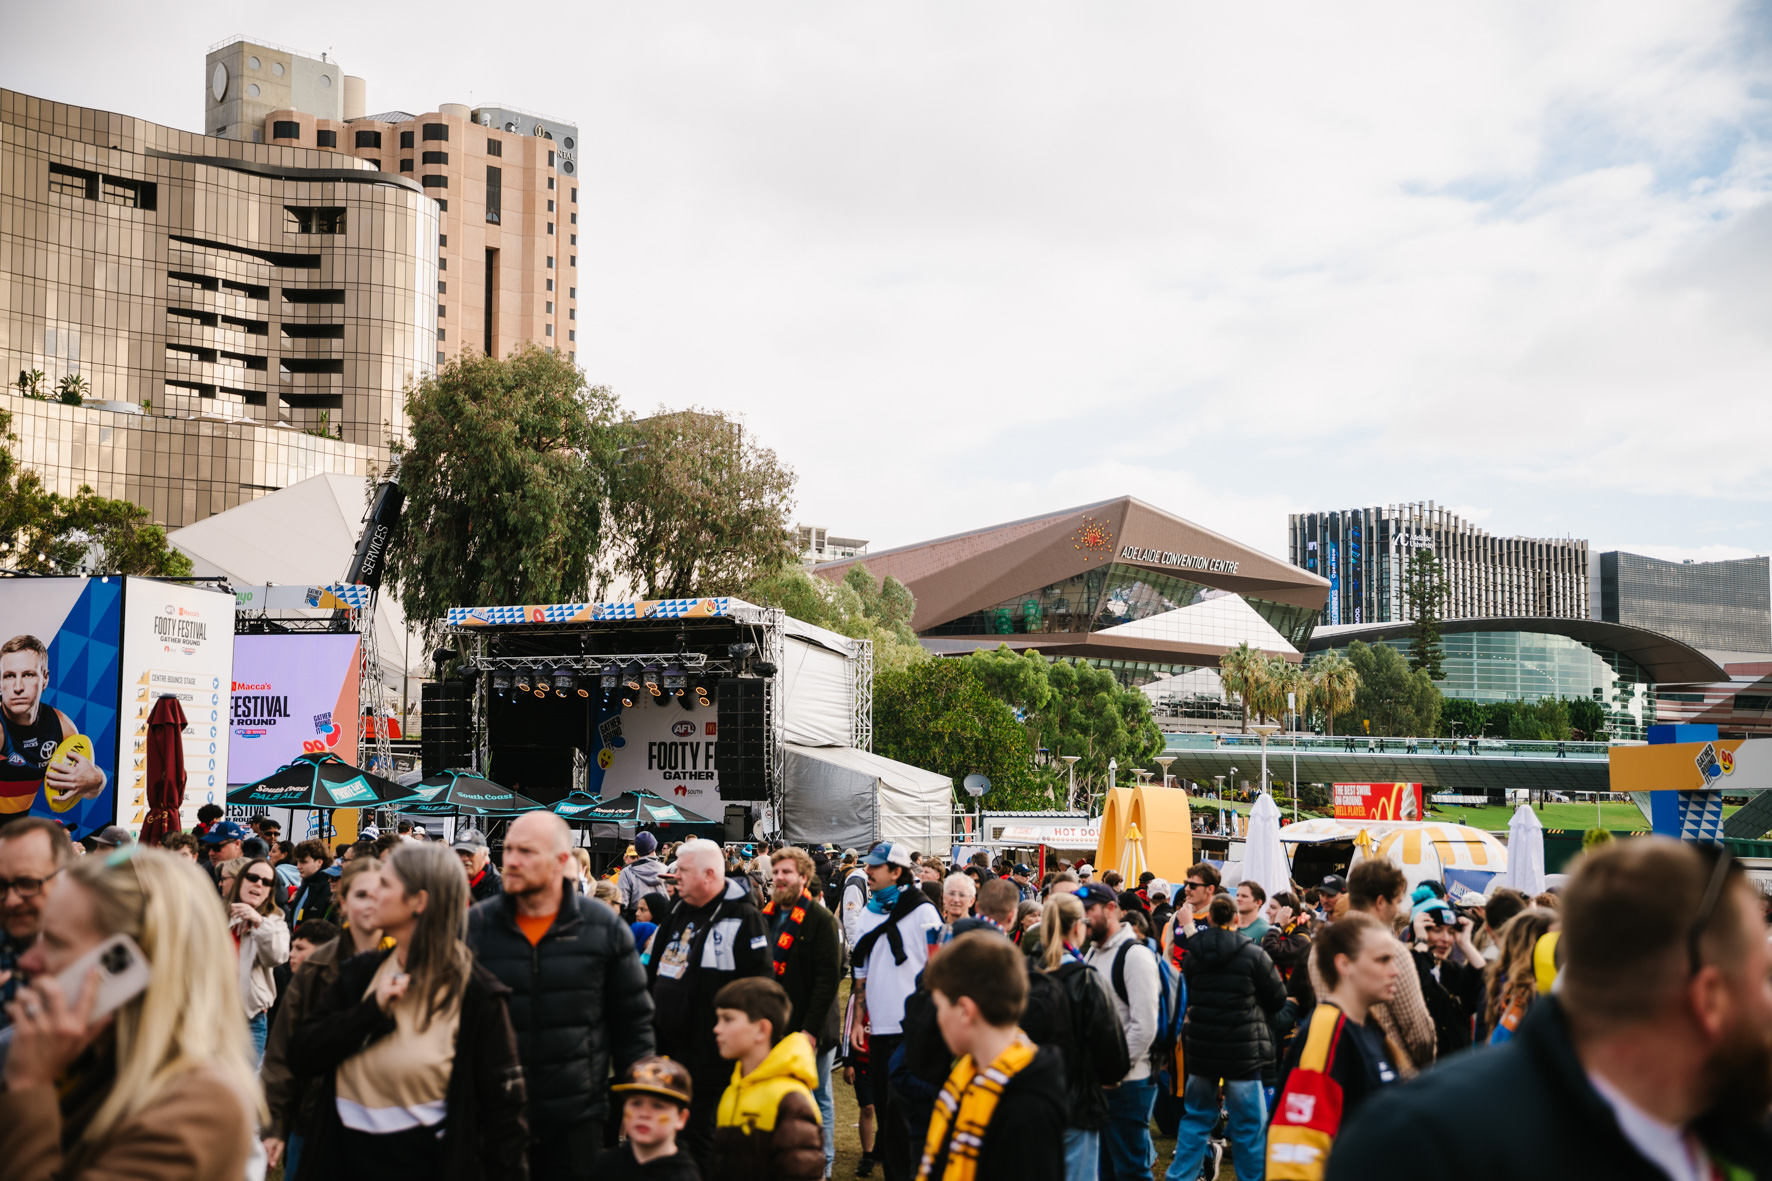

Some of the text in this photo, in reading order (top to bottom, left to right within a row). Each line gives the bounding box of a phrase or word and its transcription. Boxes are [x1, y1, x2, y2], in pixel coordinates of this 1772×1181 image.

[361, 524, 388, 575] SERVICES
[1121, 546, 1240, 574] ADELAIDE CONVENTION CENTRE
[154, 616, 207, 640] FOOTY FESTIVAL
[160, 636, 201, 647] GATHER ROUND
[151, 674, 166, 683] CENTRE
[237, 682, 272, 690] Macca's
[313, 712, 332, 722] GATHER
[600, 715, 622, 735] GATHER
[674, 724, 694, 733] AFL
[648, 742, 700, 770] FOOTY
[1696, 743, 1714, 768] GATHER
[663, 771, 715, 781] GATHER
[256, 784, 284, 793] South
[1335, 785, 1371, 796] THE BEST SWIRL
[249, 792, 279, 800] PALE
[456, 791, 483, 799] South
[1335, 796, 1342, 805] ON
[226, 805, 270, 817] FESTIVAL
[1335, 806, 1347, 816] WELL
[1054, 828, 1076, 837] HOT
